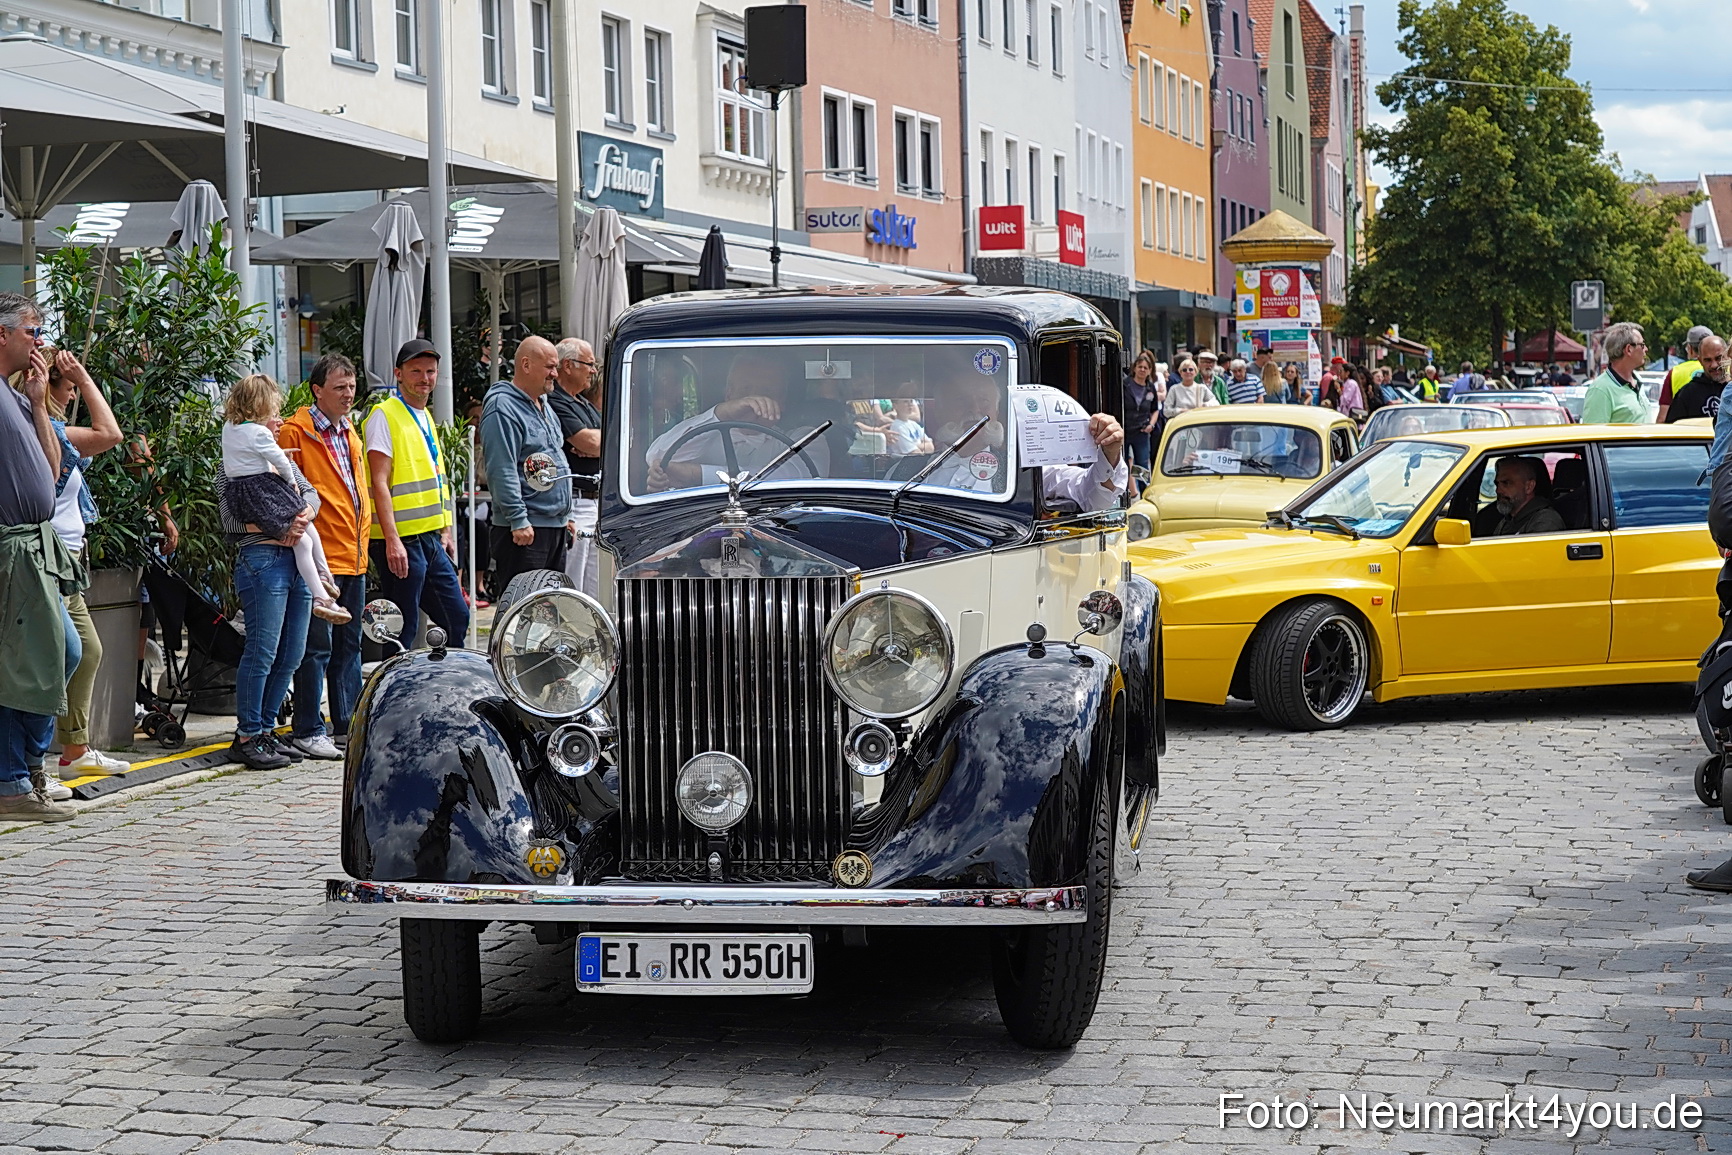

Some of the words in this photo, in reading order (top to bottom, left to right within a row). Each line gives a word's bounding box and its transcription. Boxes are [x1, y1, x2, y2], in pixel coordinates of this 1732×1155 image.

[587, 143, 663, 209] frühauf
[985, 221, 1017, 235] witt
[1723, 680, 1732, 700] NI
[586, 964, 594, 975] D
[601, 942, 641, 978] EI
[670, 942, 712, 979] RR
[722, 943, 807, 979] 550H
